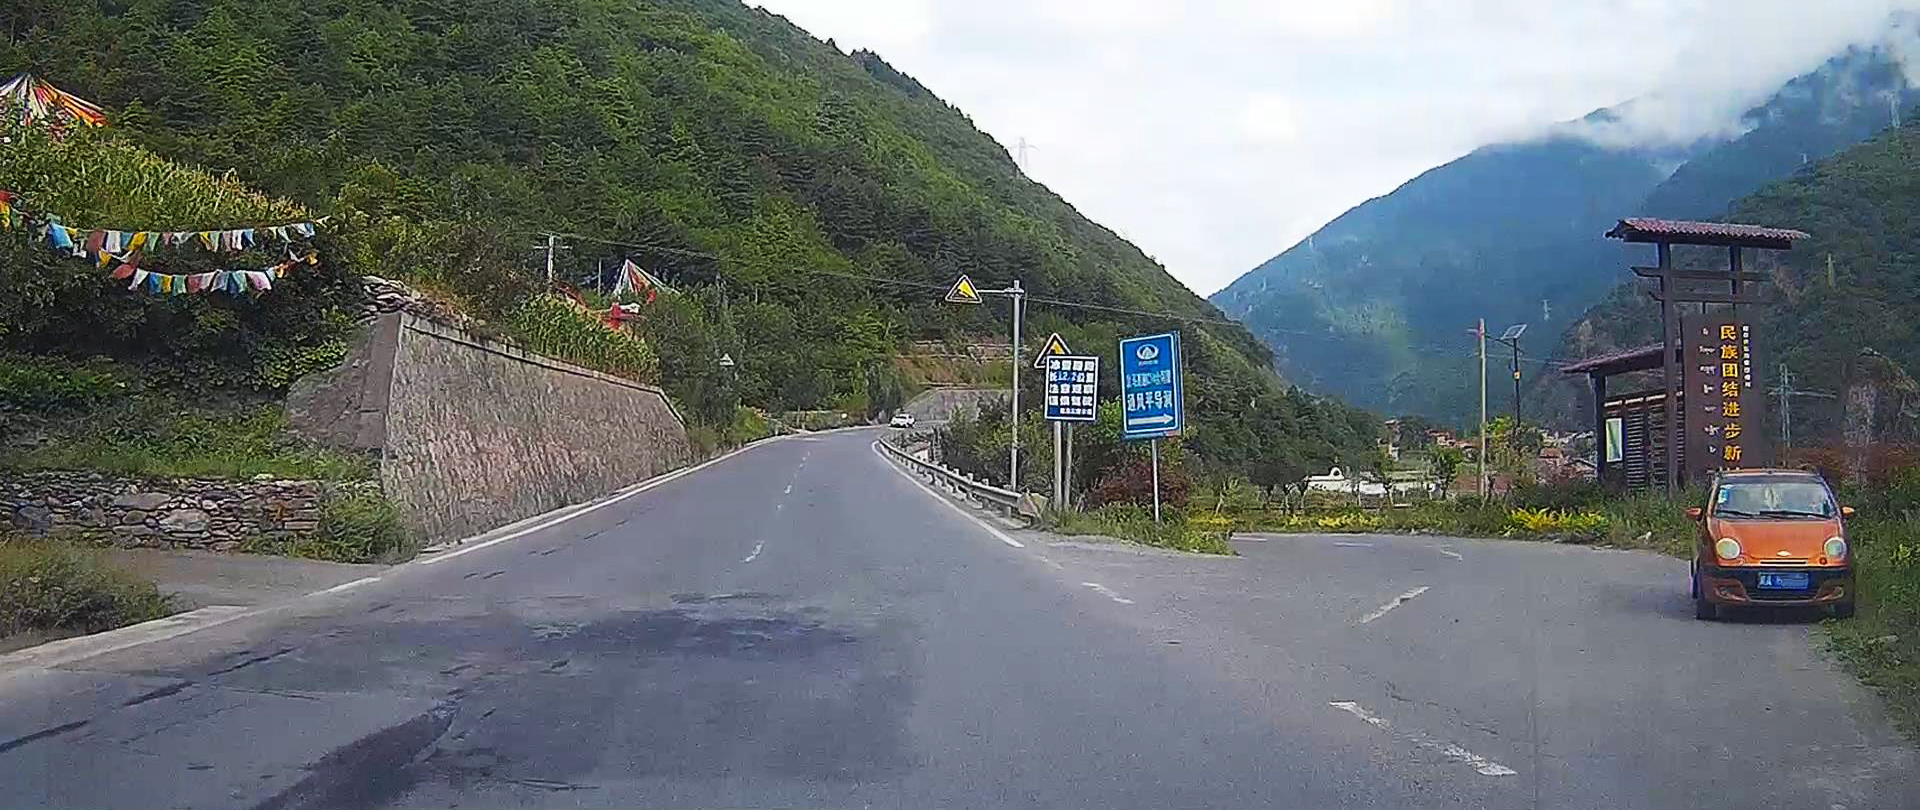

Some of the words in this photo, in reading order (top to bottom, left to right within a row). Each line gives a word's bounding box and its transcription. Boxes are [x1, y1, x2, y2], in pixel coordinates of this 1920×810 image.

[1720, 325, 1743, 470] 民族团结进步新
